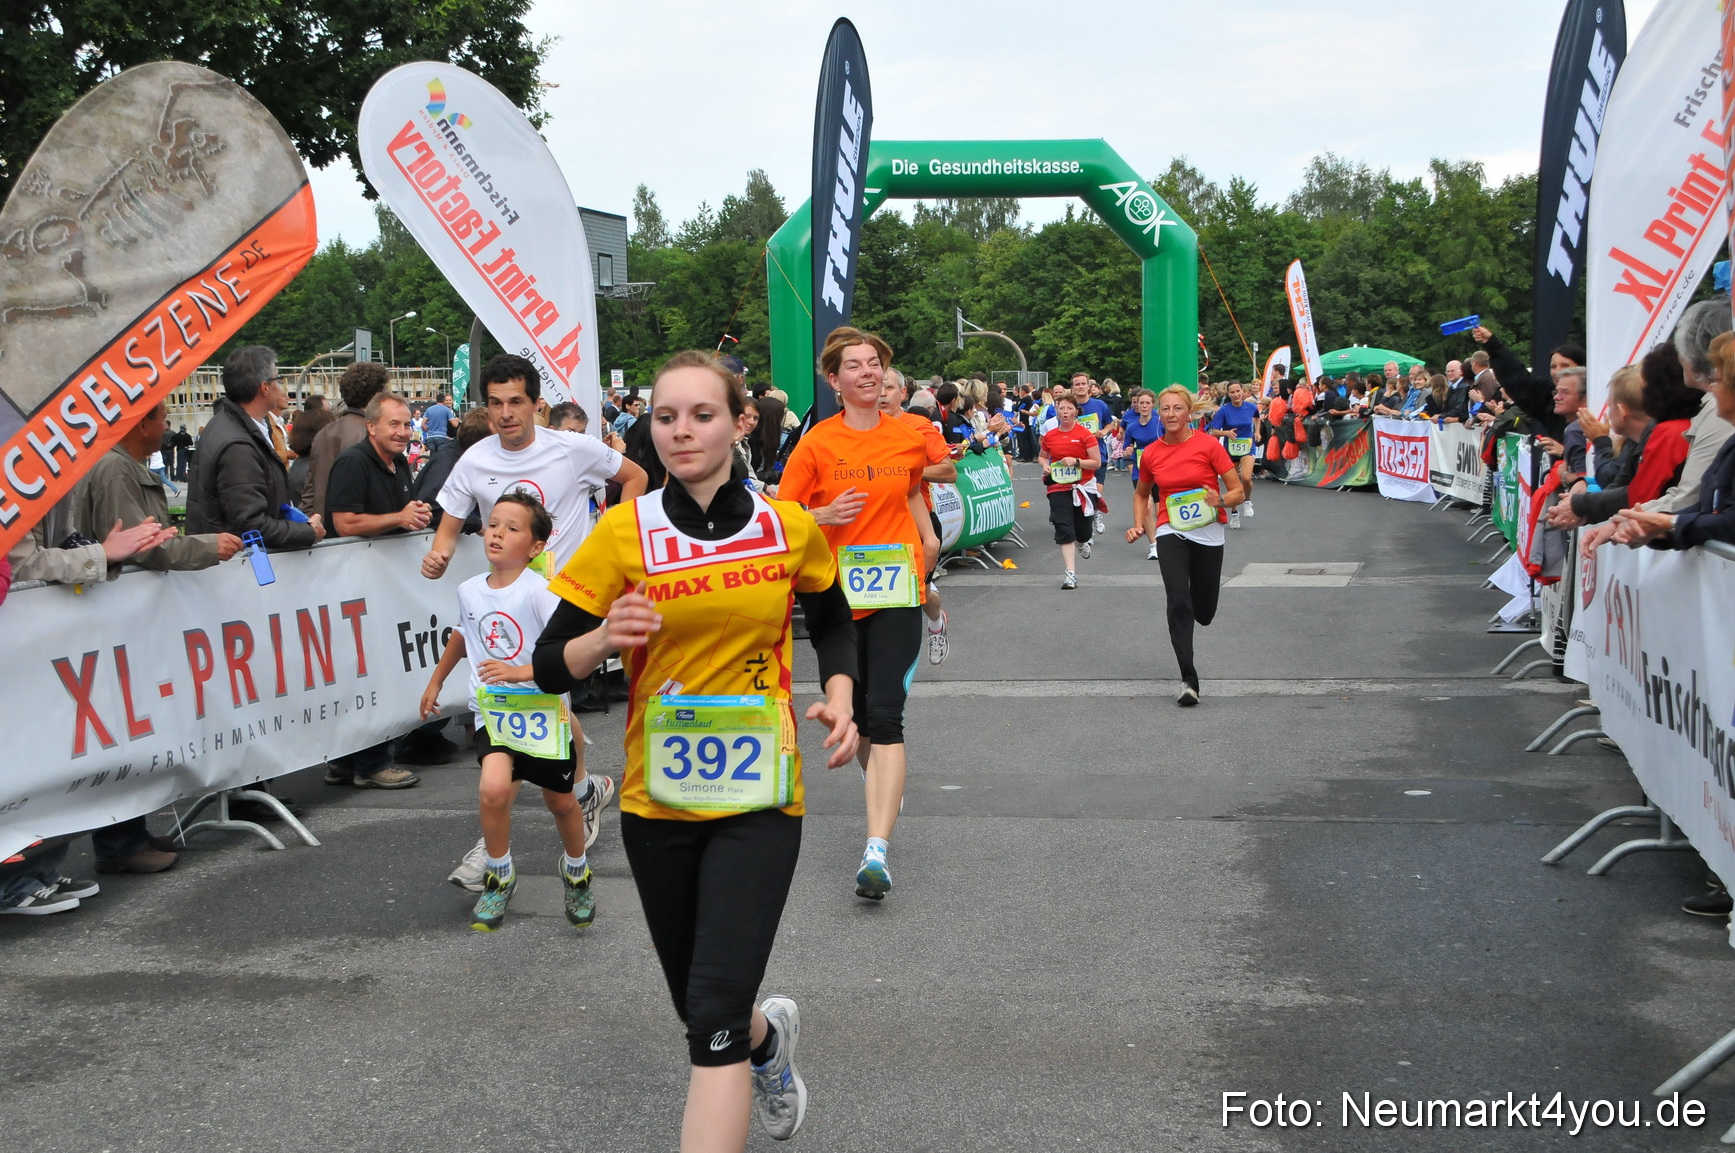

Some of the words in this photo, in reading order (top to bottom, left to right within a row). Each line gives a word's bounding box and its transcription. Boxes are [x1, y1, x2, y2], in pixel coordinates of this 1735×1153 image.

[853, 111, 862, 164] SWEDEN
[1546, 28, 1616, 287] THULE
[892, 159, 918, 175] Die
[929, 158, 1084, 176] Gesundheitskasse.
[822, 79, 864, 315] THULE
[1099, 181, 1178, 248] AOK
[1608, 246, 1673, 315] XL
[1643, 152, 1726, 259] Print
[1231, 443, 1246, 452] 151
[834, 468, 865, 480] EURO
[877, 466, 908, 476] POLES
[1053, 467, 1078, 477] 1144
[1179, 503, 1202, 520] 62
[648, 575, 714, 603] MAX
[723, 563, 790, 590] BÖGL
[848, 566, 901, 592] 627
[52, 598, 370, 760] XL-PRINT
[66, 691, 377, 794] WWW.FRISCHMANN-NET.DE
[489, 711, 548, 740] 793
[662, 735, 762, 780] 392
[680, 782, 724, 793] Simone
